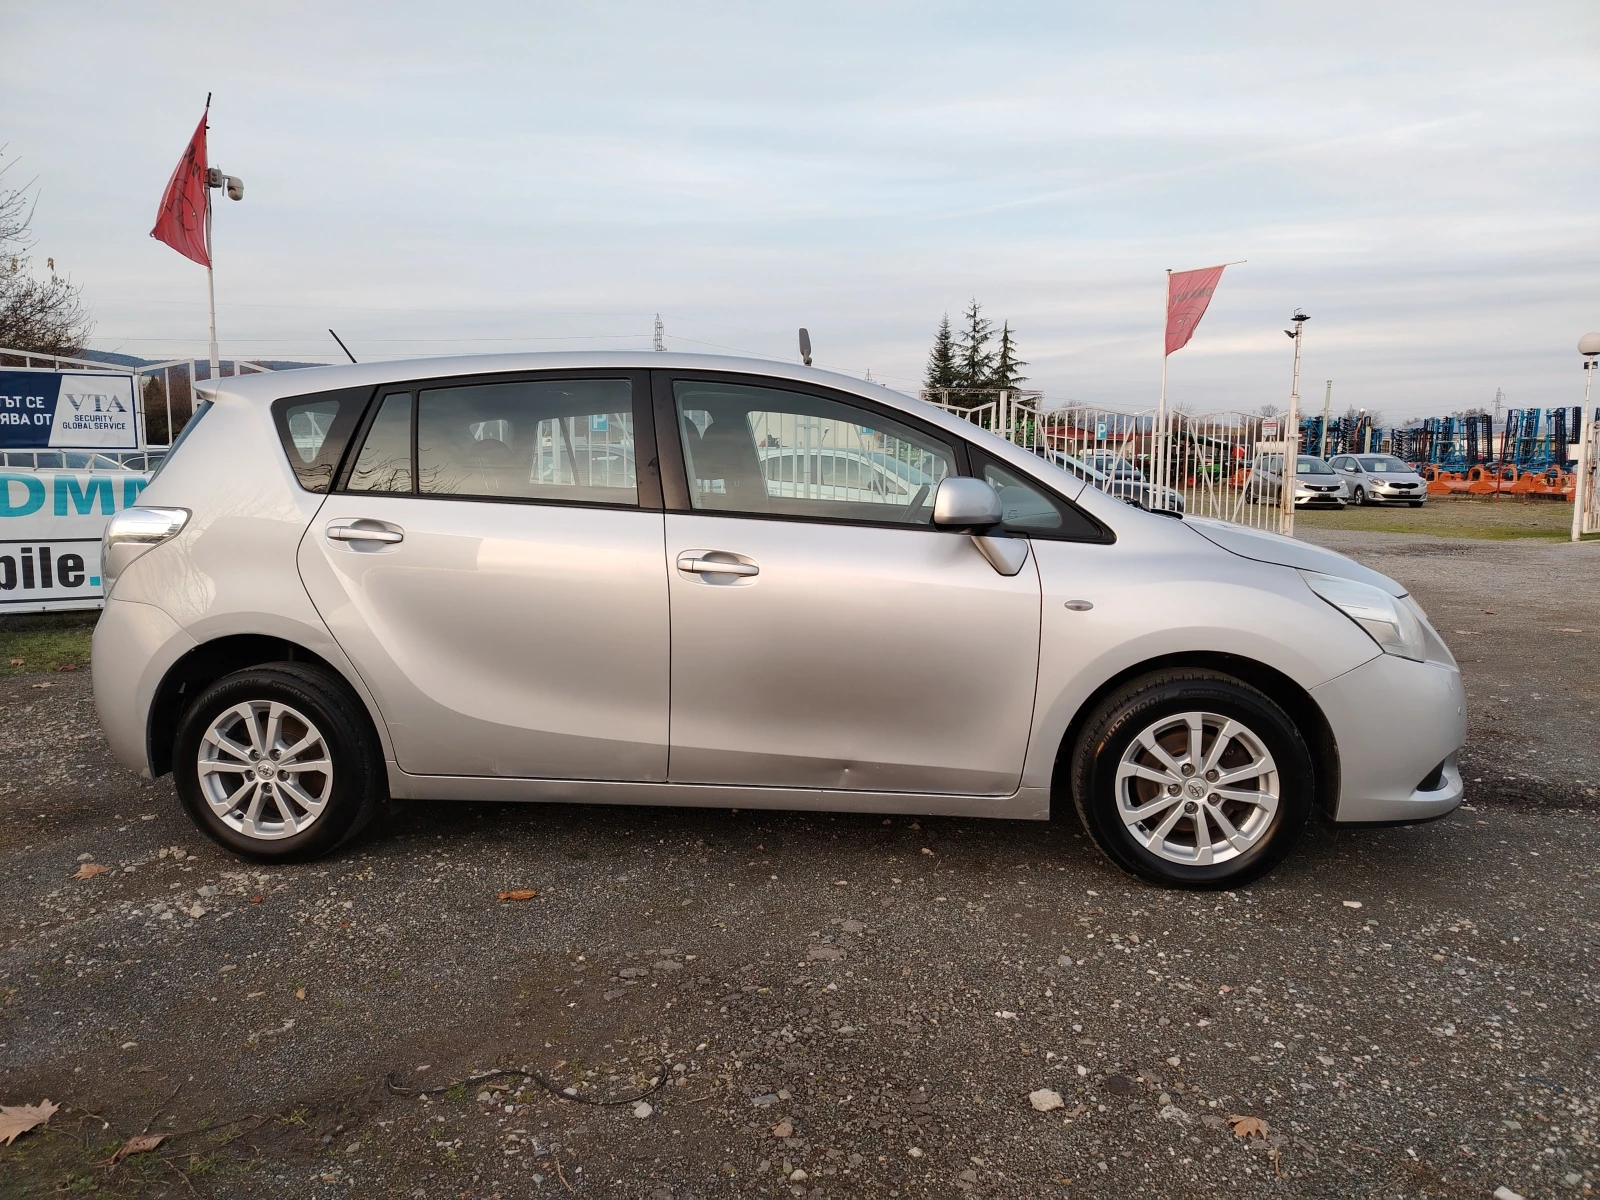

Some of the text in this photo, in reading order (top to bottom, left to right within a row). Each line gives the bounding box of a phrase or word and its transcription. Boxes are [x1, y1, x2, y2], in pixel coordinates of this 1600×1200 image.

[25, 396, 45, 409] СЕ
[64, 393, 127, 412] VTA
[33, 413, 52, 426] ОТ
[74, 414, 113, 422] SECURITY
[62, 422, 126, 430] GLOBAL SERVICE
[1097, 423, 1107, 438] P
